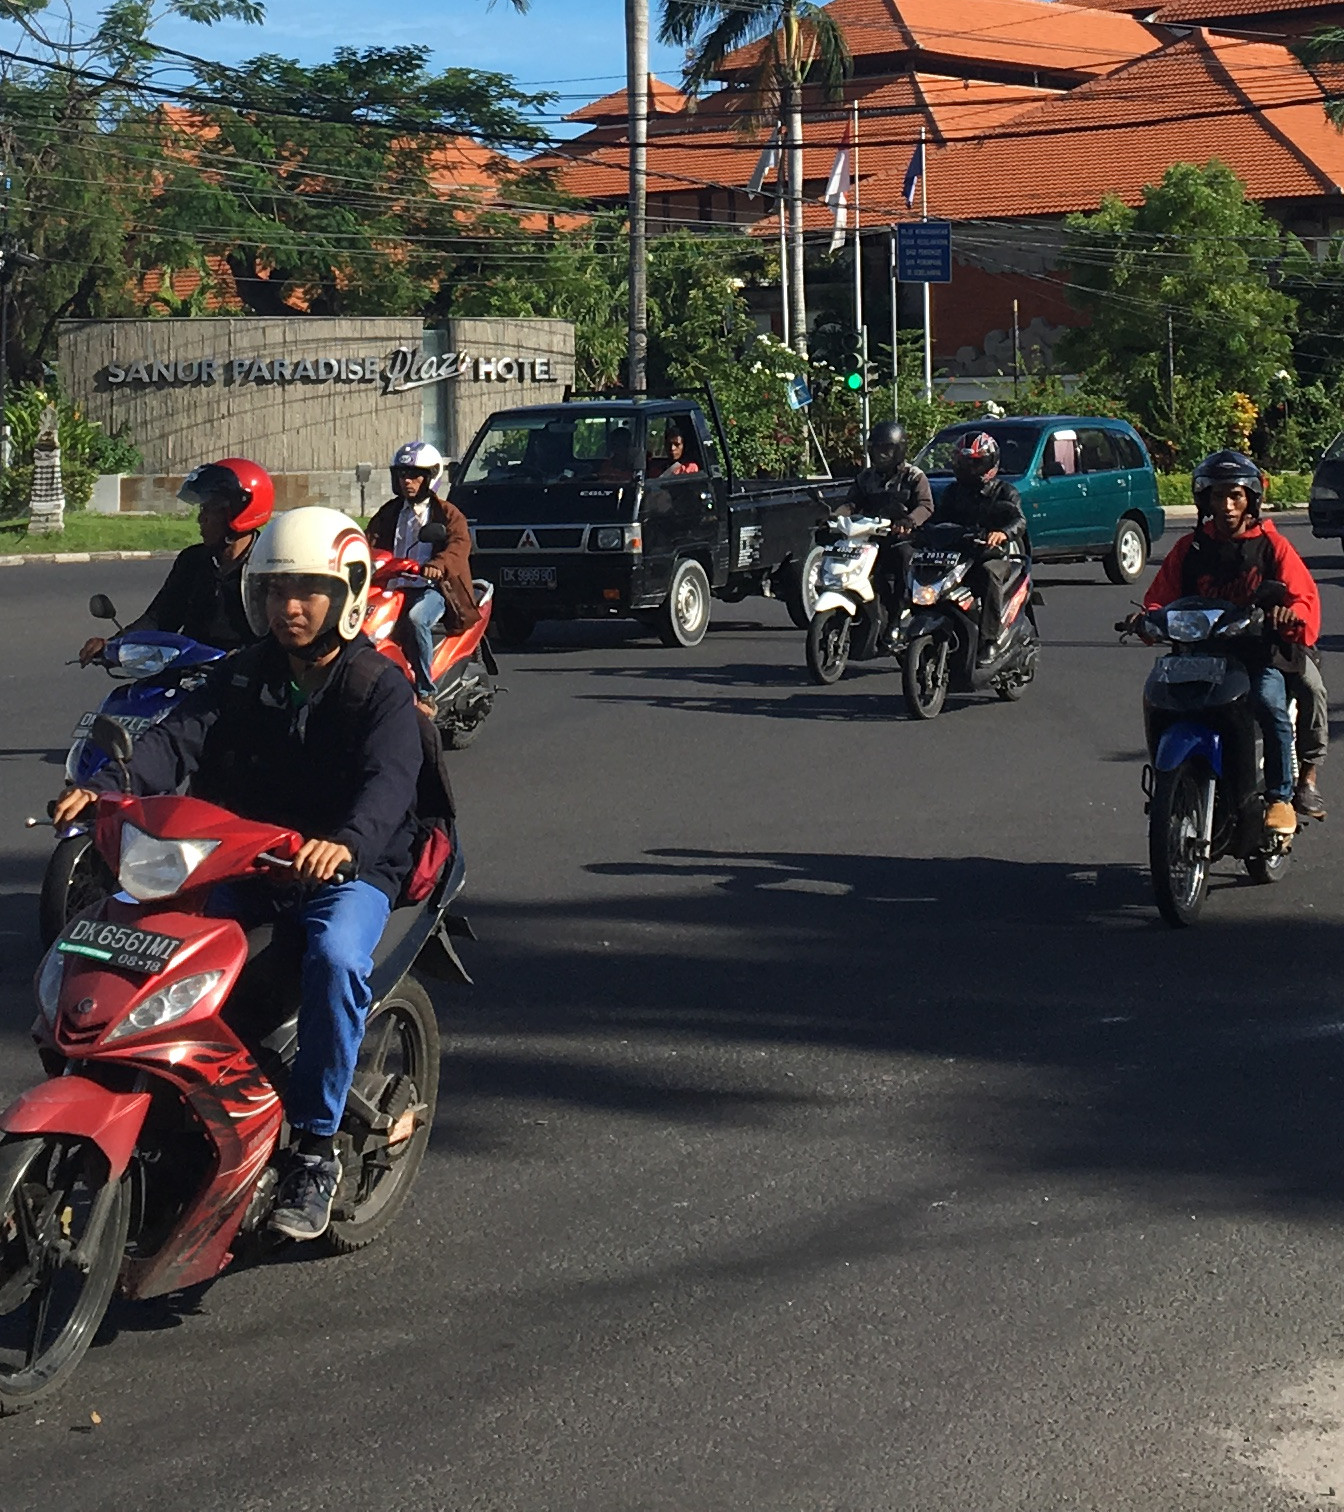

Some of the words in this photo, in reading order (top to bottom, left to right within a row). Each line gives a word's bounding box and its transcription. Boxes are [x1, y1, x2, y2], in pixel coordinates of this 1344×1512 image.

[108, 359, 218, 383] SANUR
[232, 356, 379, 381] PARADISE
[478, 356, 557, 381] HOTEL
